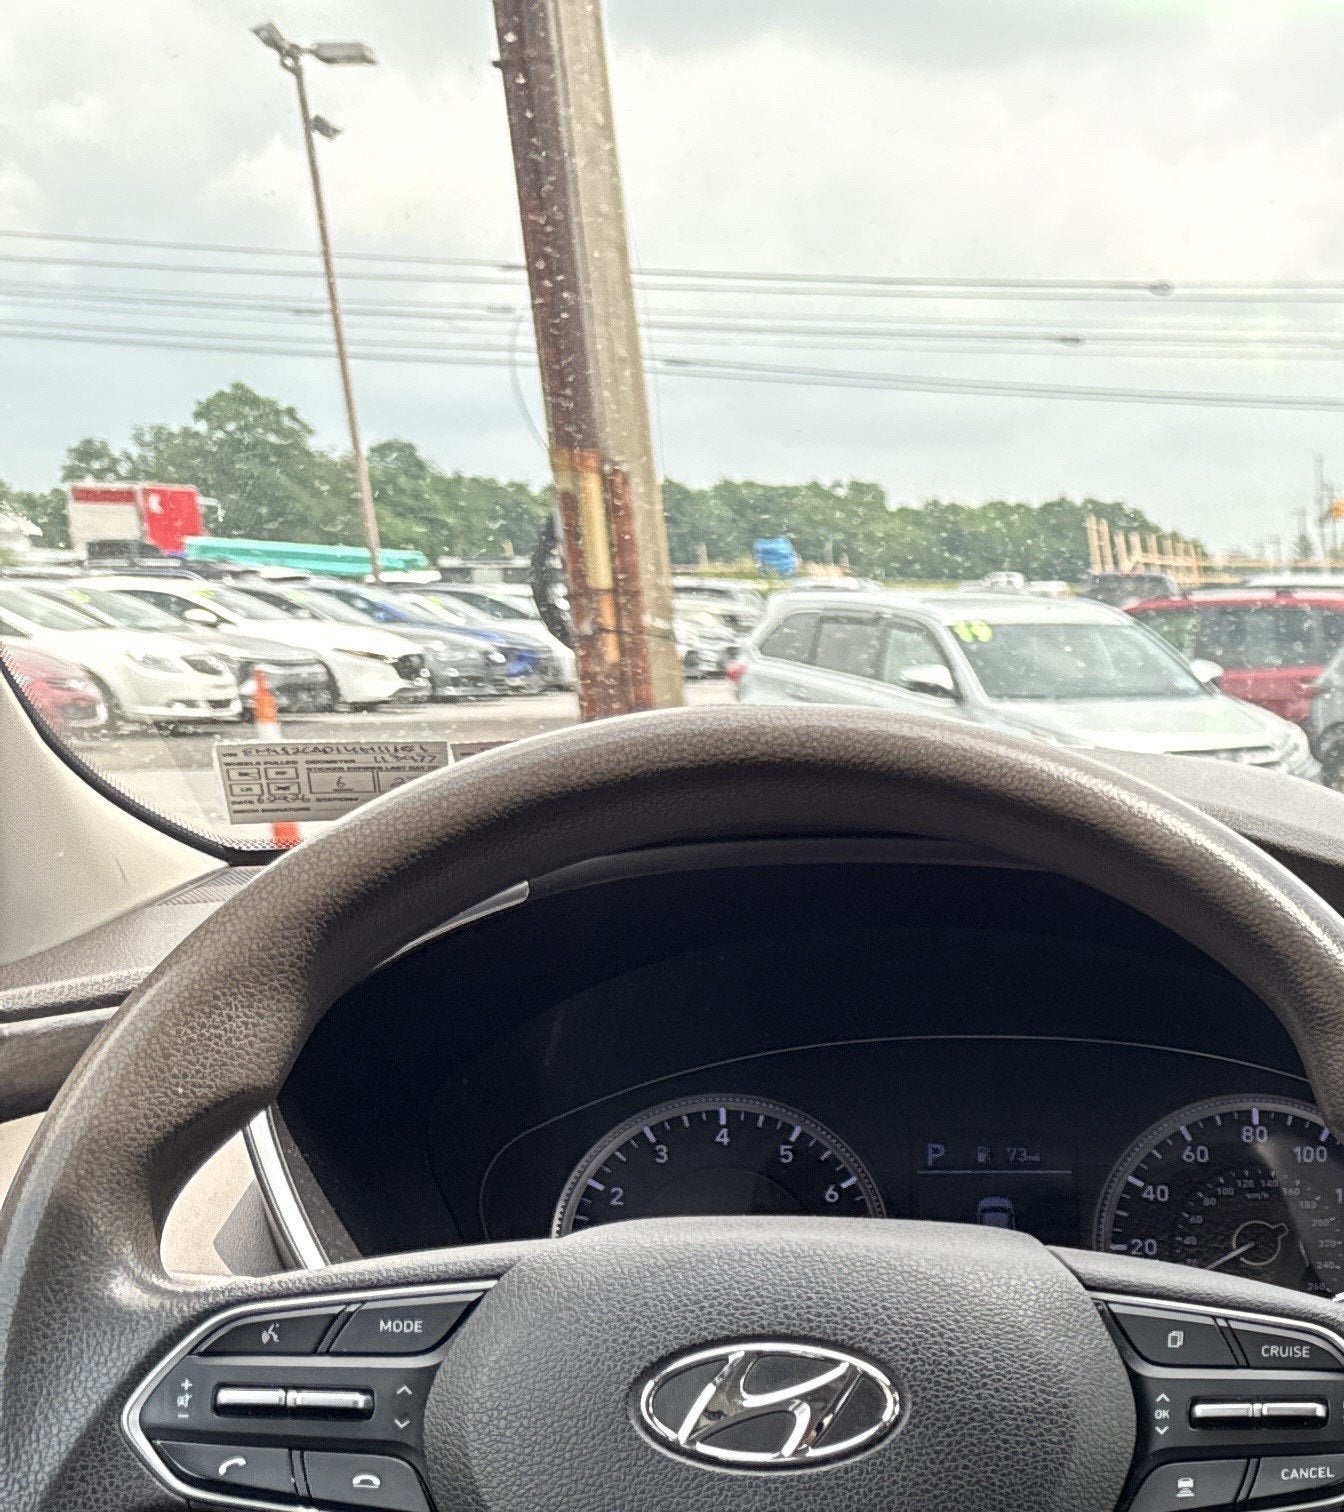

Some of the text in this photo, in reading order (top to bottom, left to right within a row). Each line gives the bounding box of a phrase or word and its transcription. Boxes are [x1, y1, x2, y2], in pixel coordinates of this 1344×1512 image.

[715, 1128, 730, 1146] 4
[1242, 1125, 1268, 1143] 80
[654, 1144, 669, 1163] 3
[780, 1144, 795, 1163] 5
[926, 1143, 946, 1167] P
[1182, 1146, 1209, 1163] 60
[1294, 1146, 1328, 1163] 100
[609, 1187, 625, 1206] 2
[824, 1184, 840, 1203] 6
[1142, 1184, 1169, 1202] 40
[1216, 1187, 1235, 1197] 100
[1131, 1238, 1158, 1255] 20
[379, 1319, 424, 1334] MODE
[1261, 1345, 1311, 1359] CRUISE
[1154, 1409, 1171, 1419] OK
[1280, 1467, 1335, 1481] CANCEL
